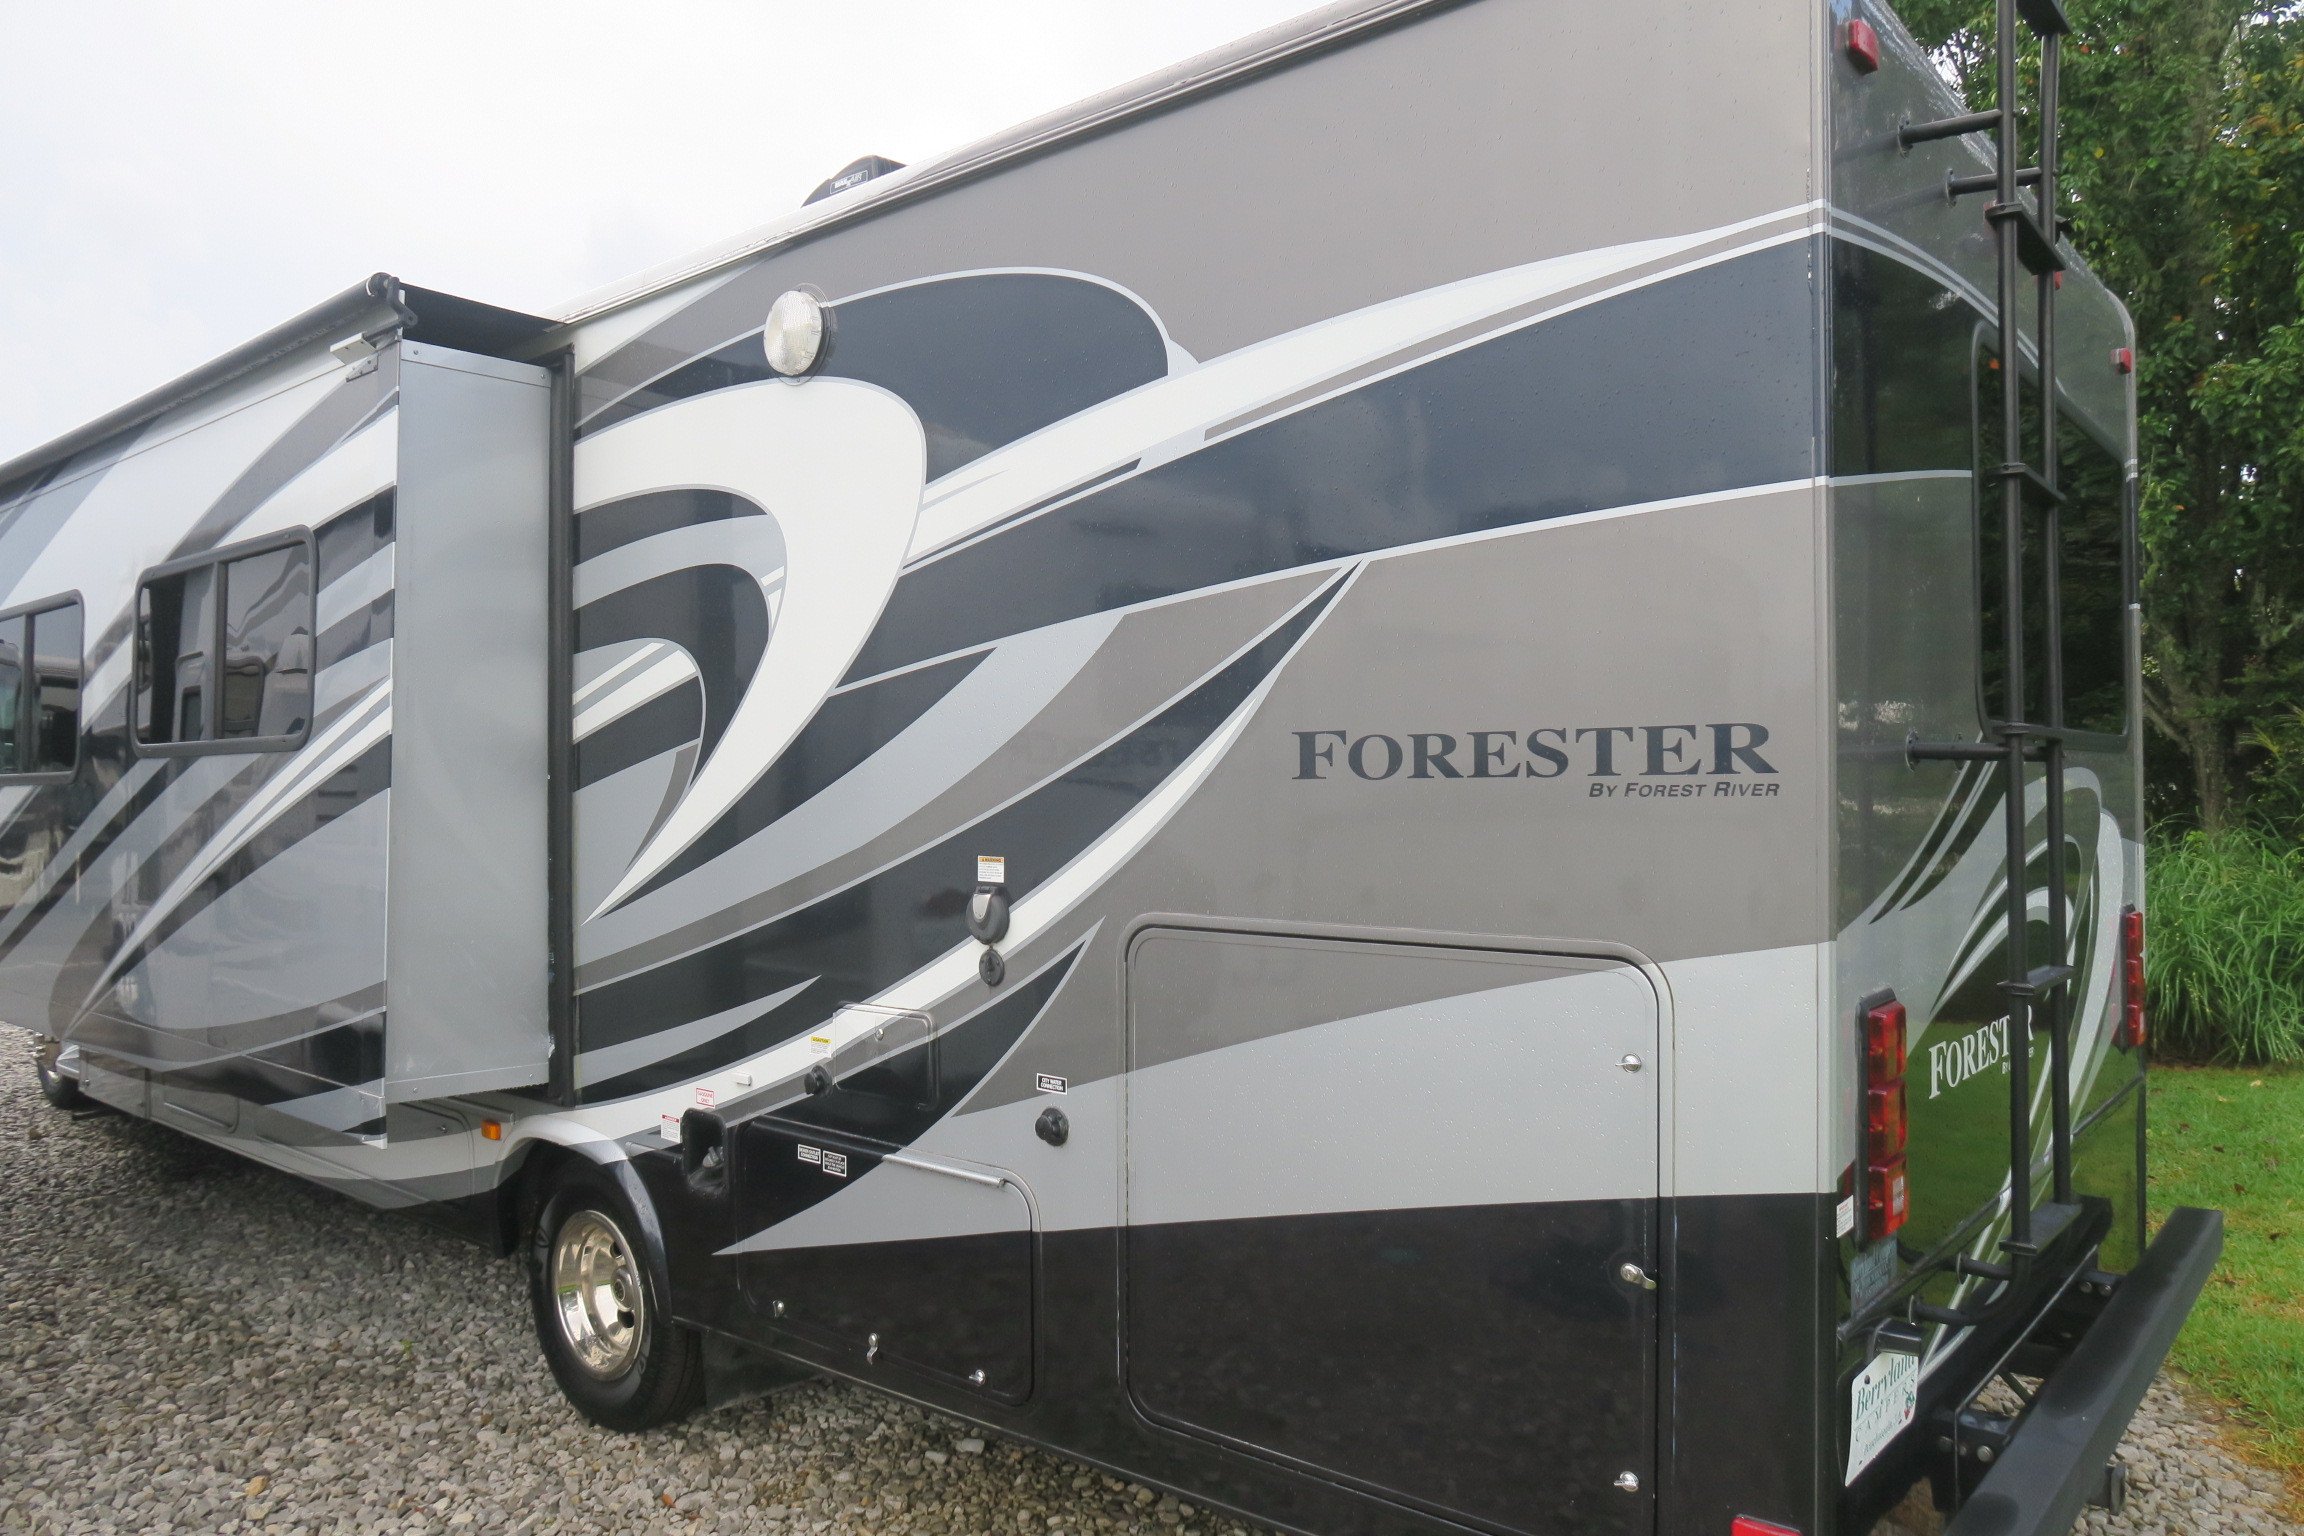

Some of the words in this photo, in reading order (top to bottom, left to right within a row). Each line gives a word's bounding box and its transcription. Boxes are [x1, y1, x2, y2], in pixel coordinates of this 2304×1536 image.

[1292, 722, 1779, 780] FORESTER
[1589, 782, 1617, 798] BY
[1624, 782, 1707, 798] FOREST
[1714, 781, 1780, 798] RIVER
[1928, 1005, 2034, 1100] FOREST
